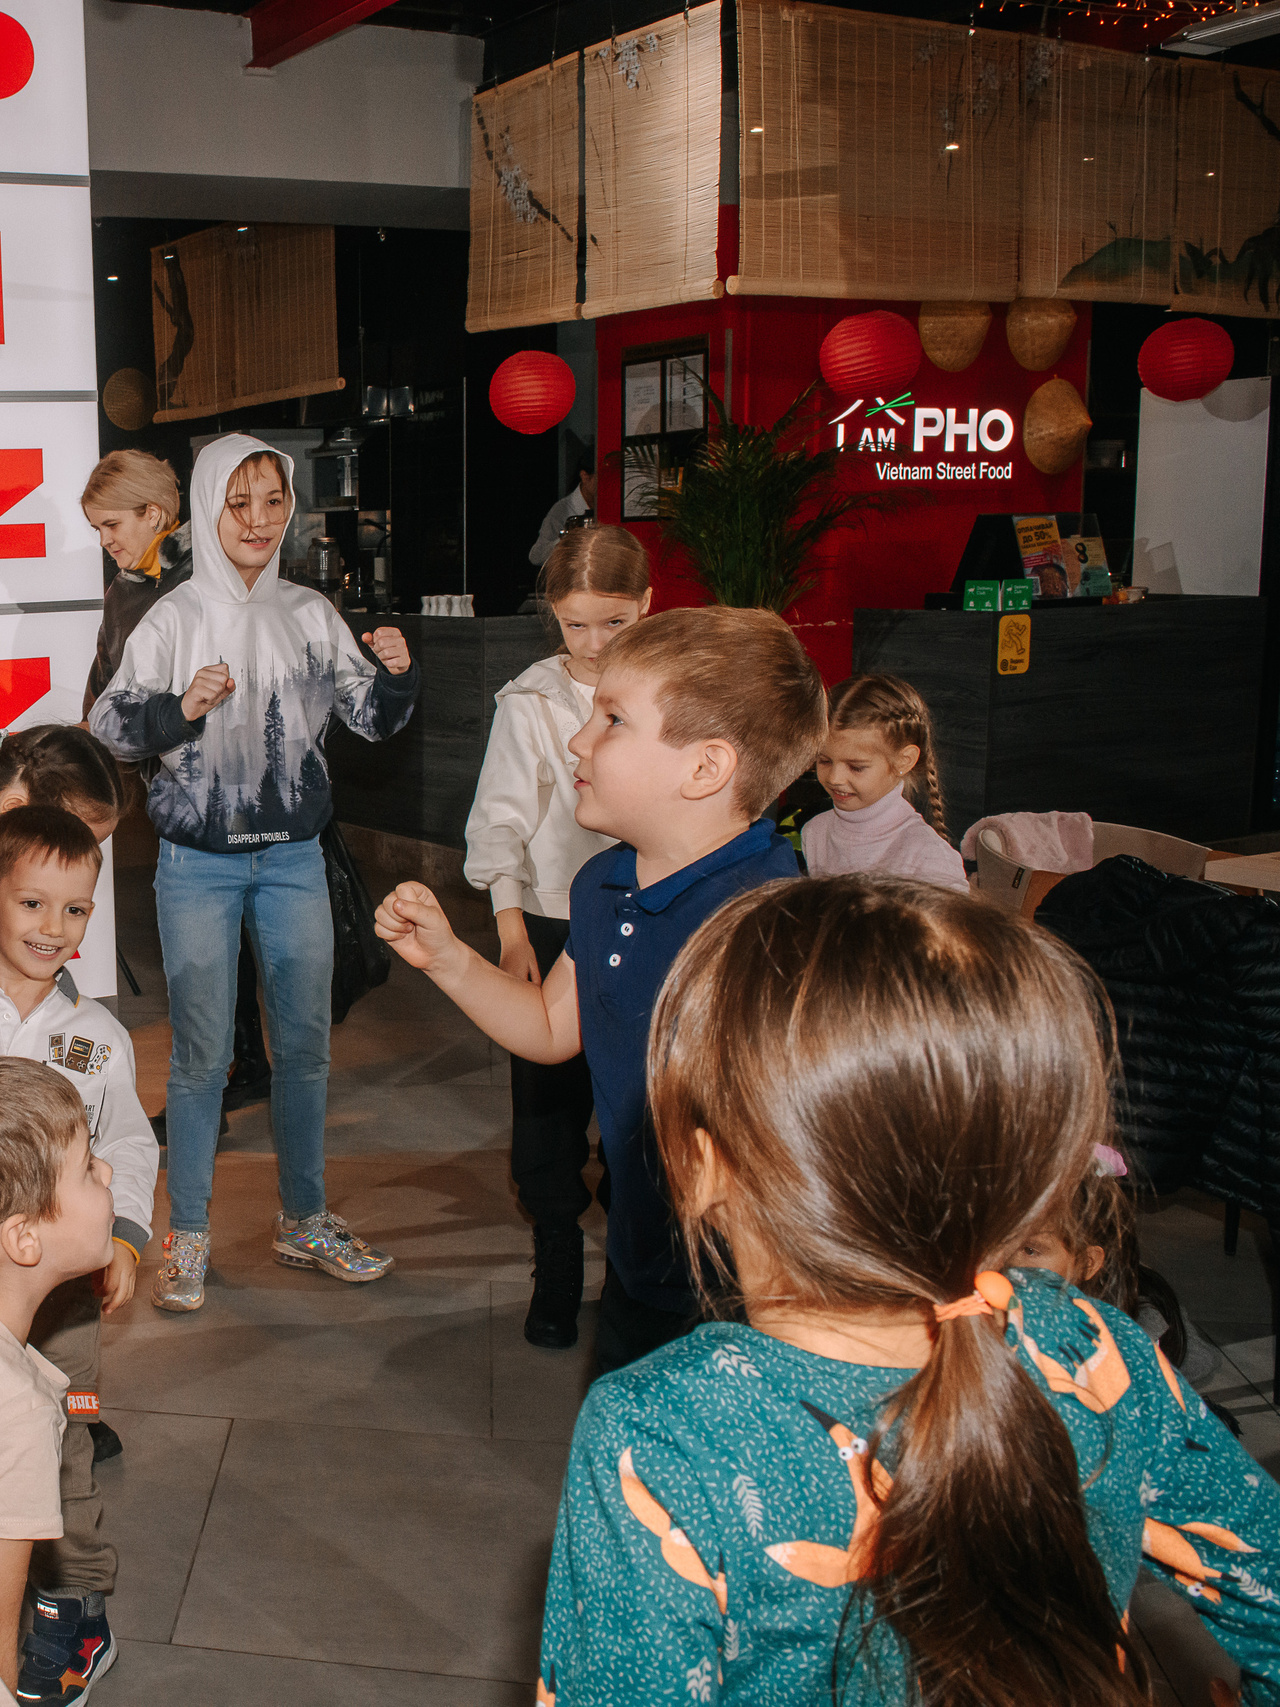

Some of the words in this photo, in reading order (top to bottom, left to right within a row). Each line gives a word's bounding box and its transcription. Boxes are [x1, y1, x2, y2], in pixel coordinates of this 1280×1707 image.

[857, 427, 896, 452] AM
[913, 407, 1015, 452] PHO
[876, 461, 933, 480] Vietnam
[936, 461, 976, 480] Street
[979, 461, 1013, 480] Food
[227, 833, 260, 844] DISAPPEAR
[261, 831, 290, 842] TROUBLES
